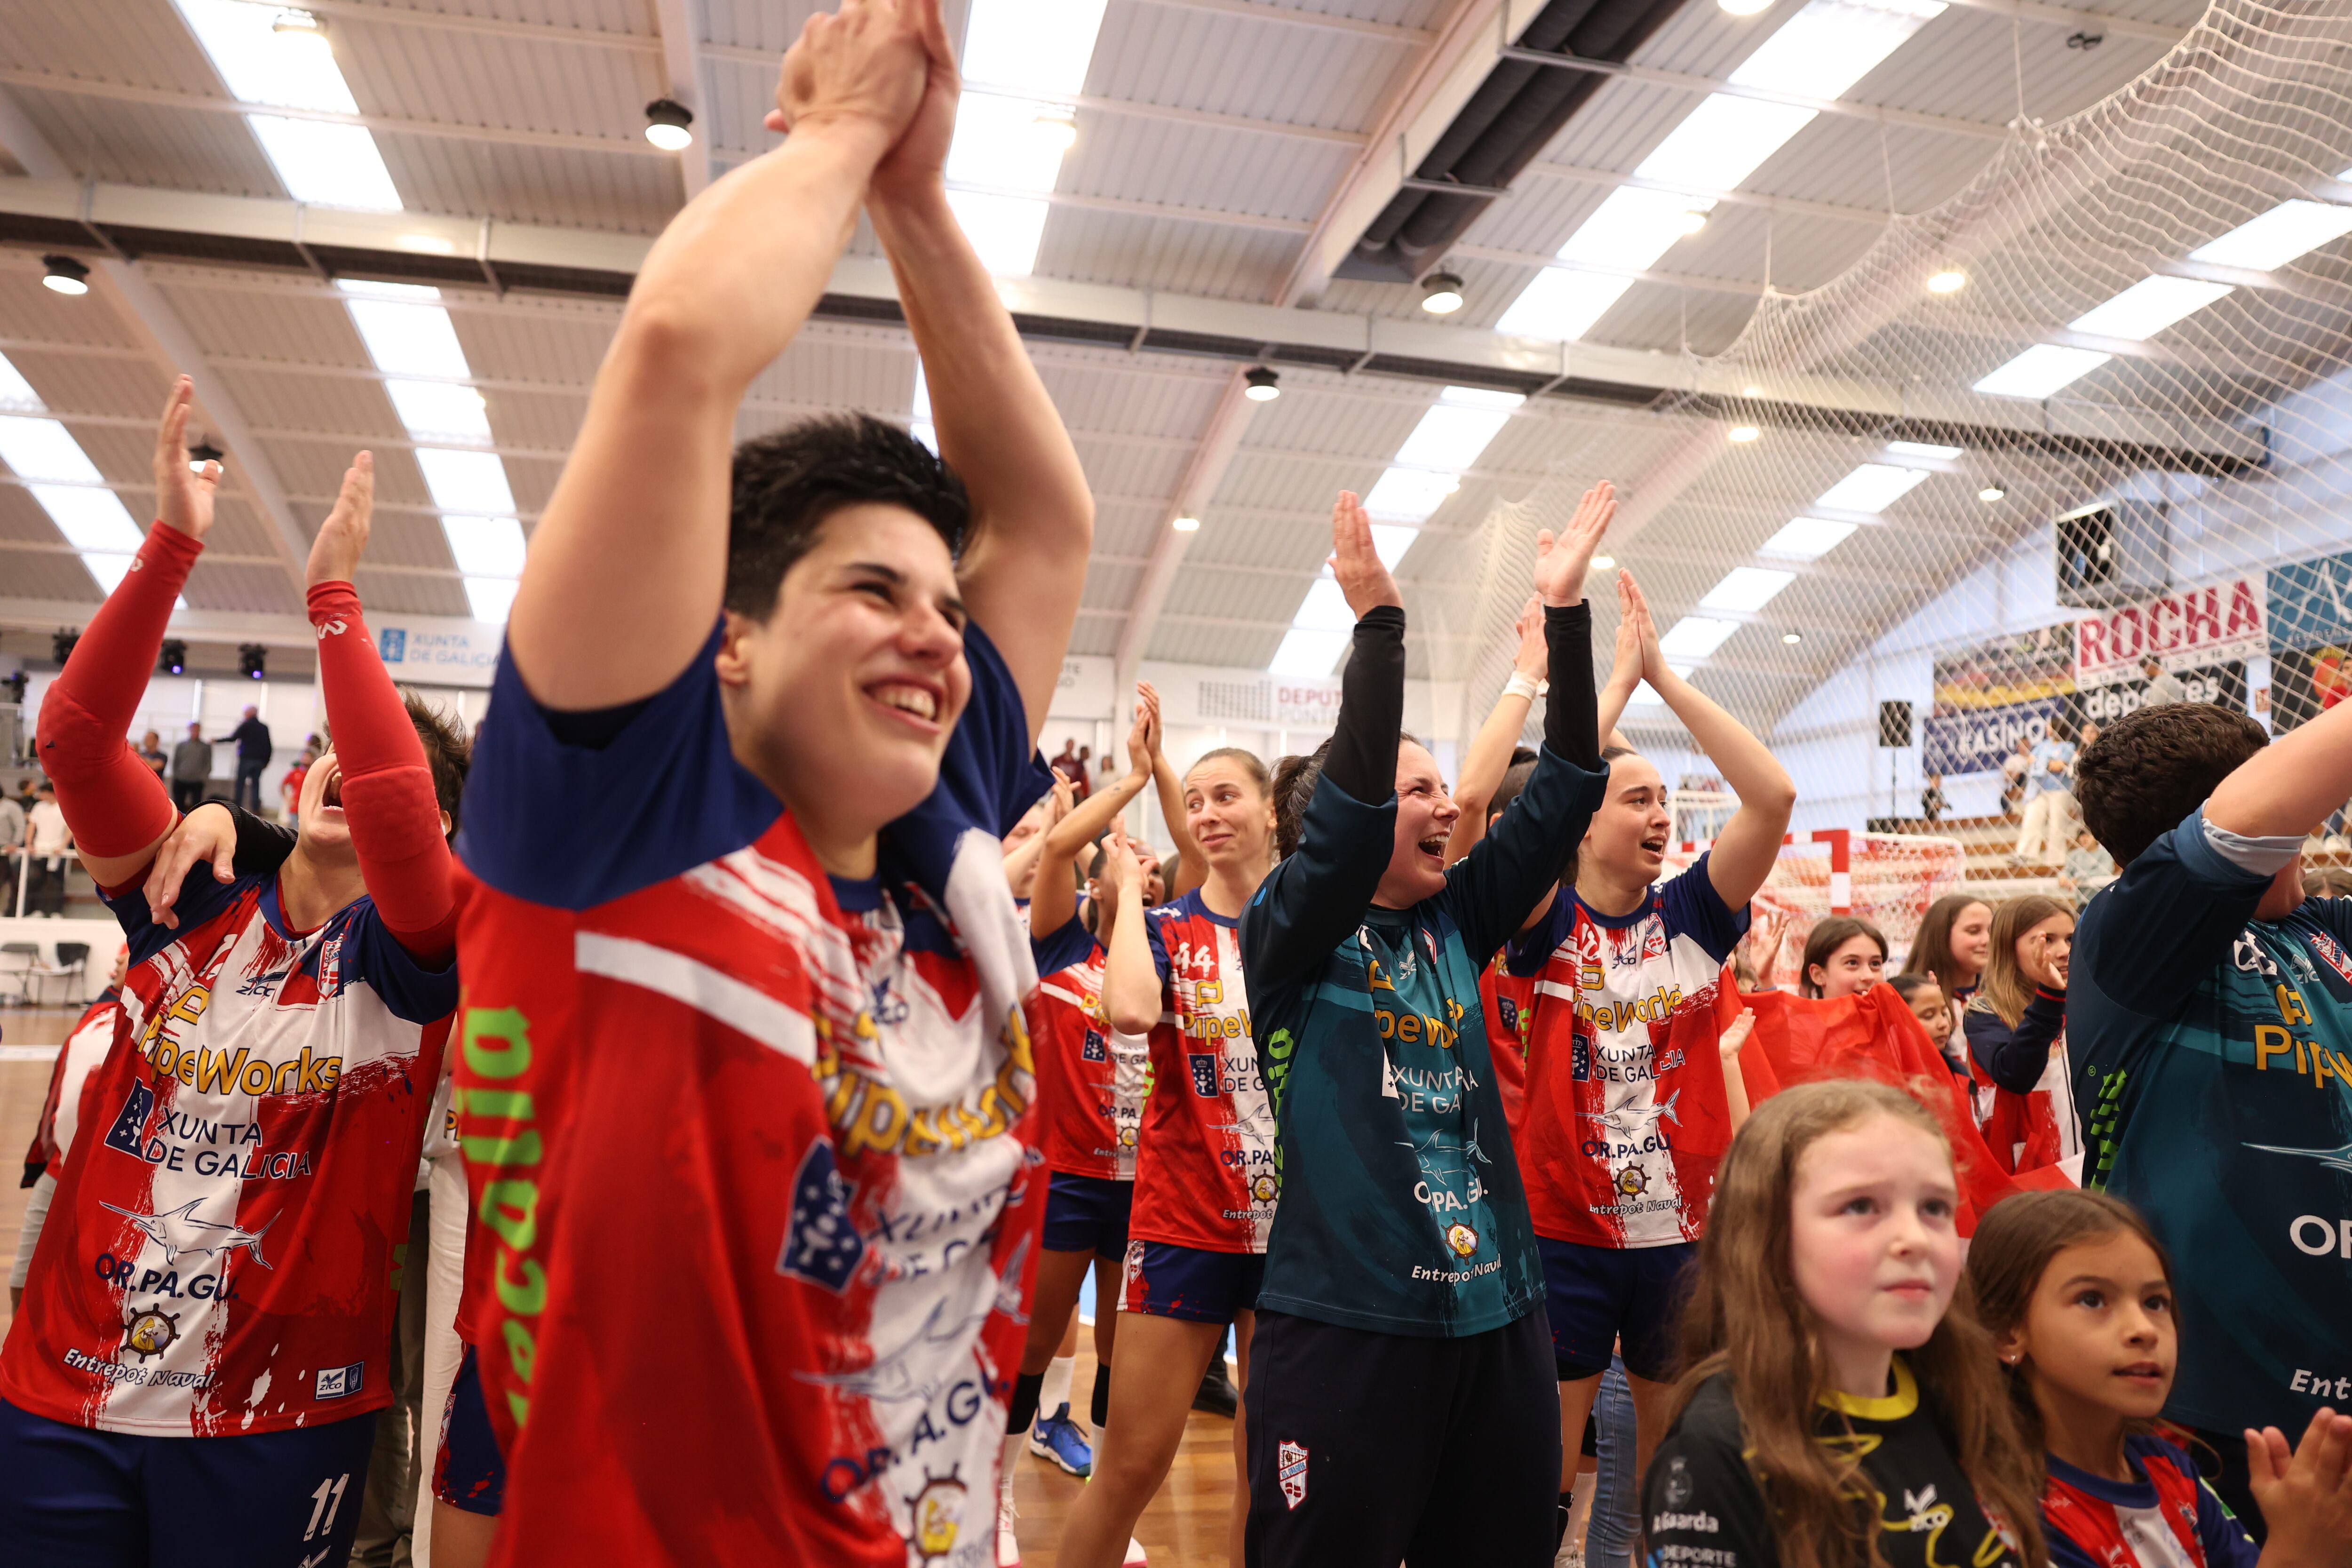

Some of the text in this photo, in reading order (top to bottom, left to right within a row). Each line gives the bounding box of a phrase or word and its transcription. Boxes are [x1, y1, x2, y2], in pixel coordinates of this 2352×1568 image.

[2079, 581, 2262, 667] ROCHA
[410, 648, 431, 662] DE
[1594, 1043, 1656, 1063] XUNTA
[1596, 1048, 1685, 1082] DE GALCIA
[1224, 1077, 1248, 1092] DE
[156, 1106, 262, 1147] XUNTA
[143, 1135, 311, 1179] DE GALICIA
[1222, 1209, 1273, 1222] Entrepot
[1646, 1195, 1684, 1212] Naval
[95, 1253, 239, 1301] OR.PA.GU.
[63, 1348, 216, 1388] Entrepot Naval
[303, 1472, 350, 1542] 11
